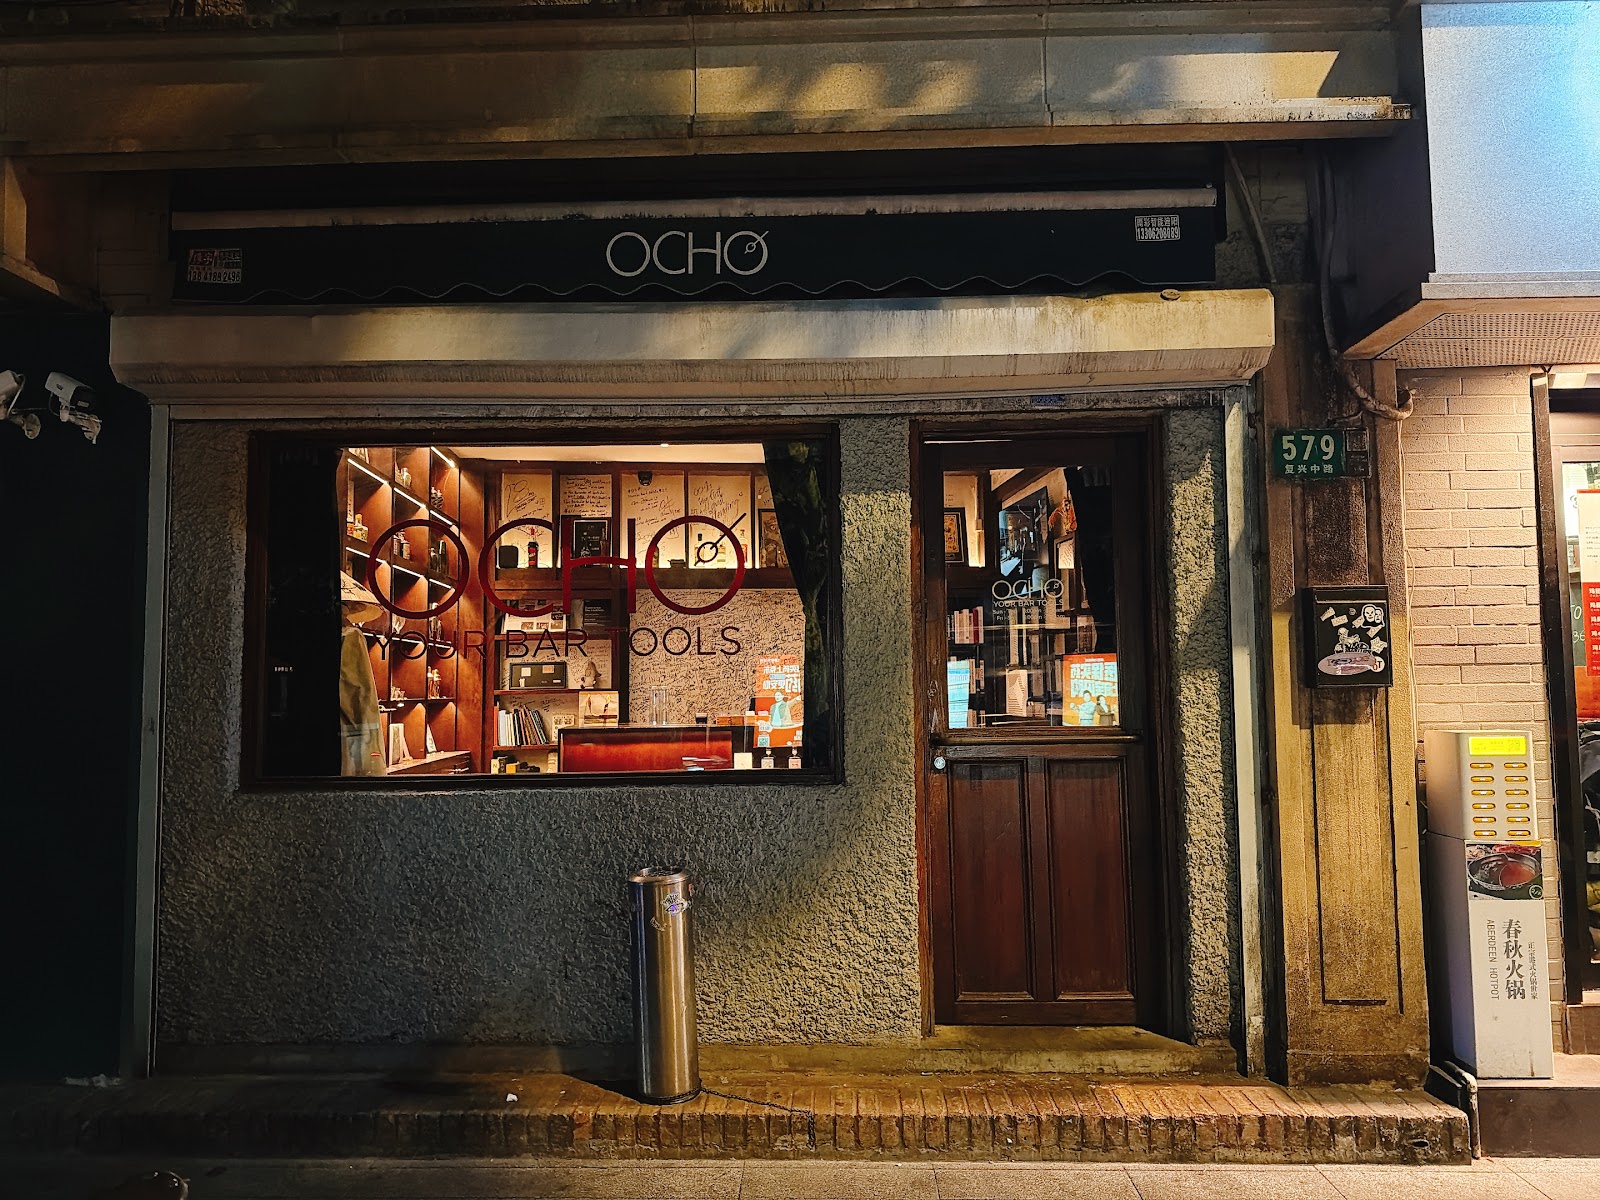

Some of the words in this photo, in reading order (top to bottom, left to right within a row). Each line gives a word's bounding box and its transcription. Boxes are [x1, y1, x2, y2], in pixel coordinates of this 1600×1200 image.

[606, 231, 769, 277] OCHO
[1282, 435, 1335, 460] 579
[1284, 464, 1334, 474] 复兴中路
[367, 513, 747, 619] OCHO
[992, 579, 1064, 600] OCHO
[374, 630, 487, 661] YOUR
[505, 629, 588, 658] BAR
[605, 626, 742, 657] TOOLS
[1487, 919, 1498, 963] ABERDEEN
[1502, 919, 1526, 1000] 春秋火锅
[1489, 967, 1500, 1000] HOTPOT
